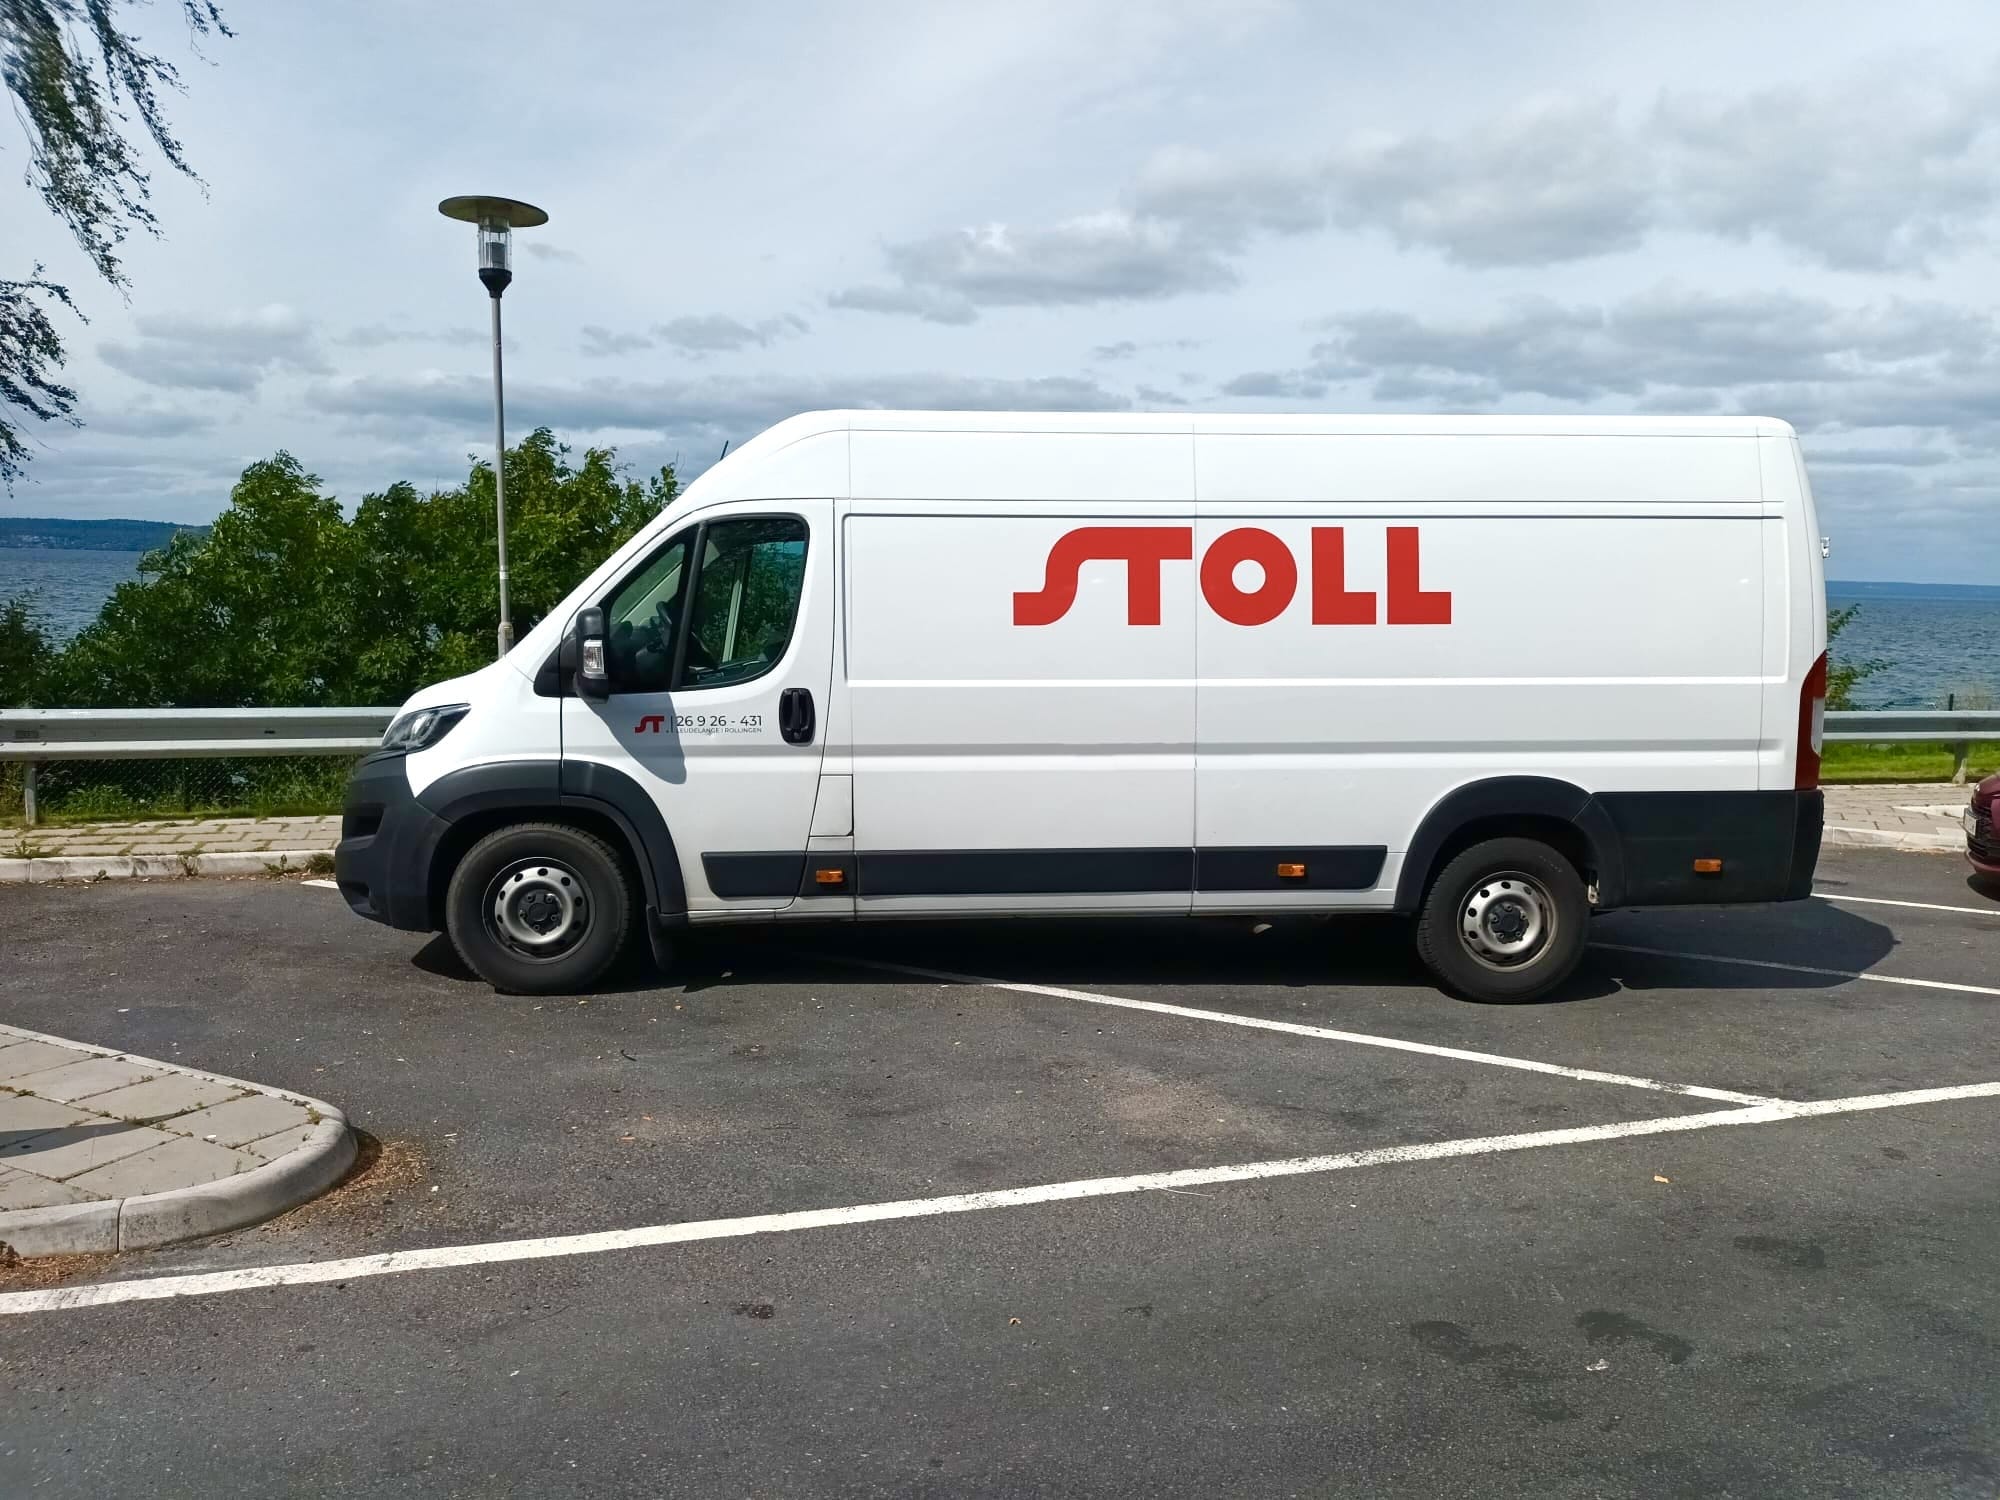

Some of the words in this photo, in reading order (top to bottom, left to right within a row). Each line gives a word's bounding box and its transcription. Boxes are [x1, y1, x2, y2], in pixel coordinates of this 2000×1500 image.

[1014, 527, 1452, 626] STOLL
[676, 715, 694, 727] 26
[697, 715, 706, 727] 9
[710, 715, 727, 727] 26
[739, 715, 762, 727] 431
